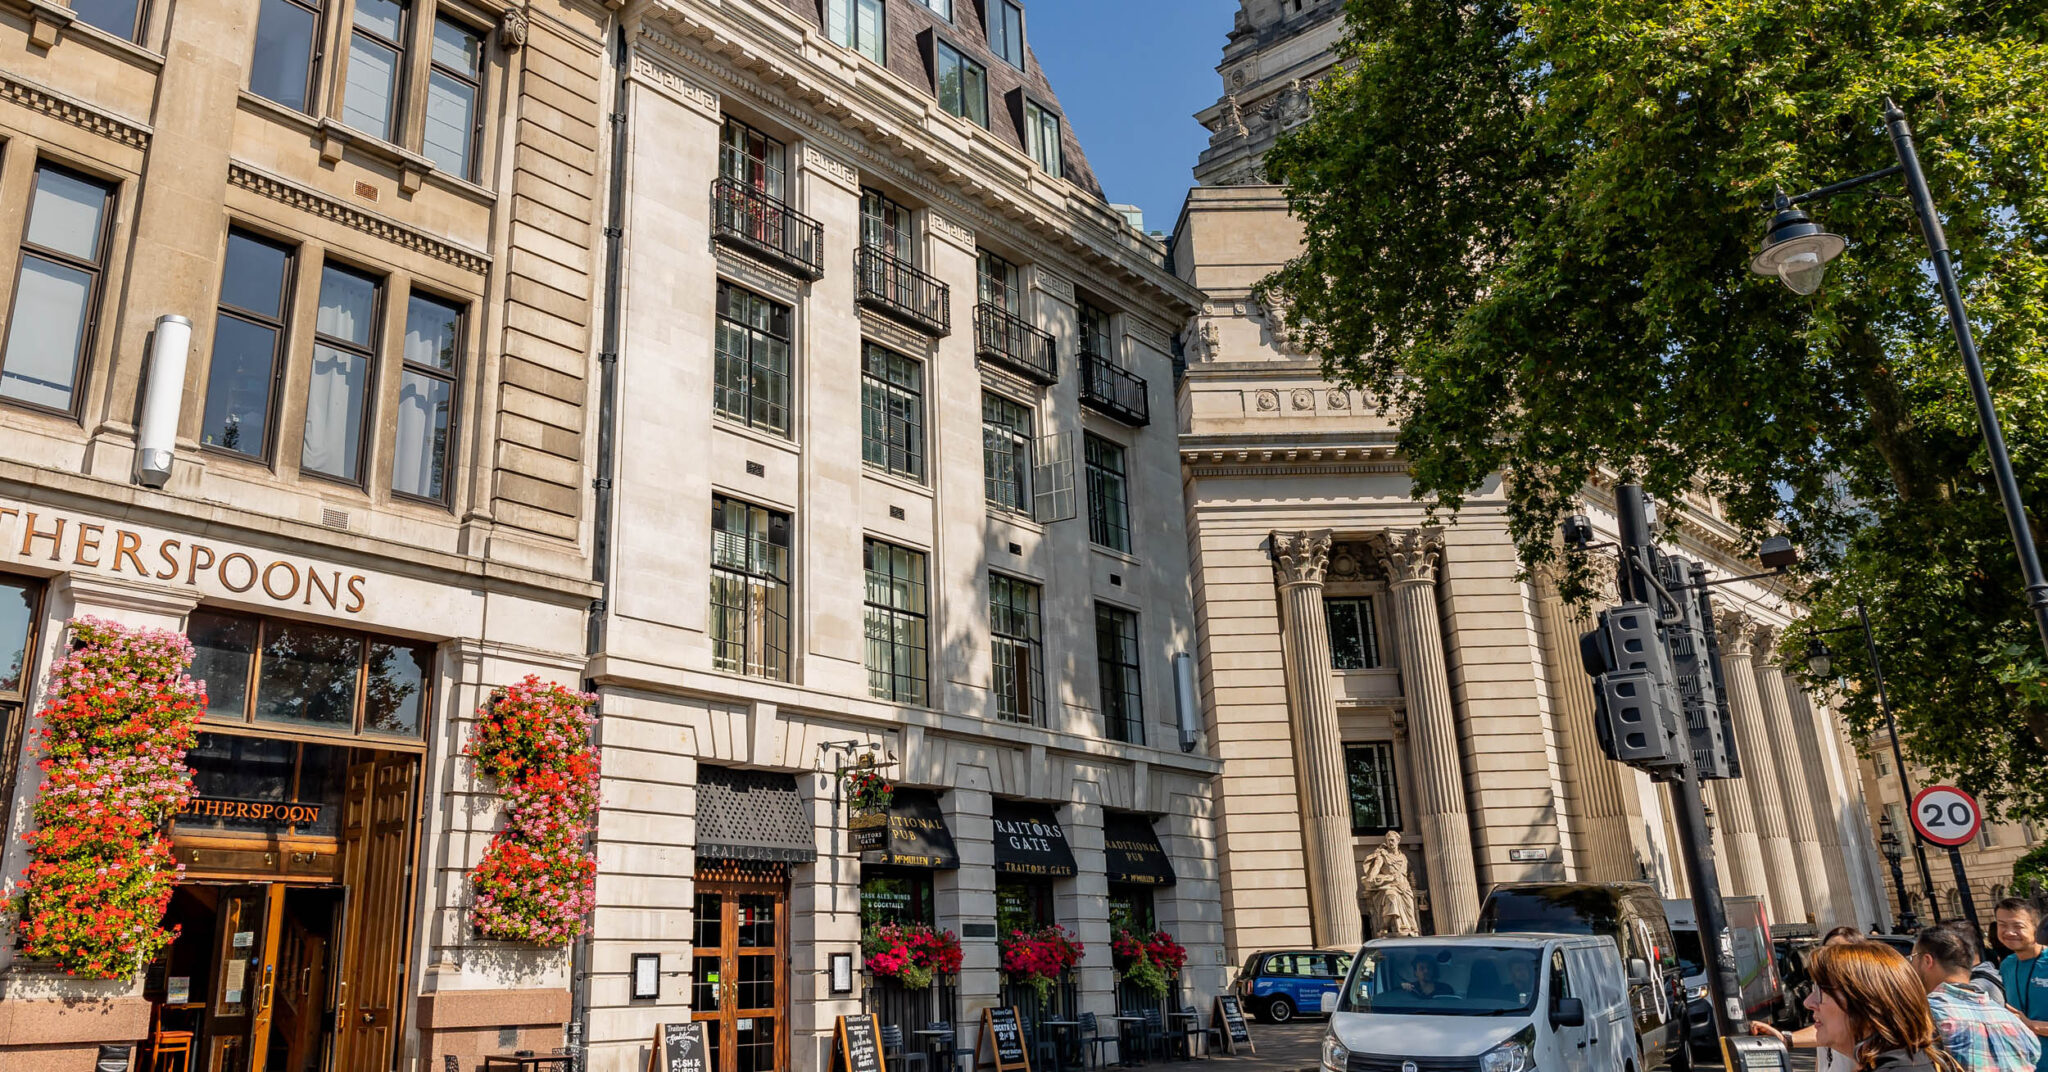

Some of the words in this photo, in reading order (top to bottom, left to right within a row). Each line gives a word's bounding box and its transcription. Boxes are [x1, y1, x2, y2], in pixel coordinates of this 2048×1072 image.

[1923, 802, 1971, 827] 20
[855, 832, 882, 840] TRAITORS
[892, 829, 916, 841] PUB
[1009, 836, 1051, 852] GATE
[702, 844, 774, 861] TRAITORS
[1125, 852, 1144, 862] PUB
[1004, 862, 1047, 875] TRAITORS
[1050, 865, 1072, 875] GATE
[667, 1024, 686, 1032] Traitors
[671, 1057, 693, 1068] FISH
